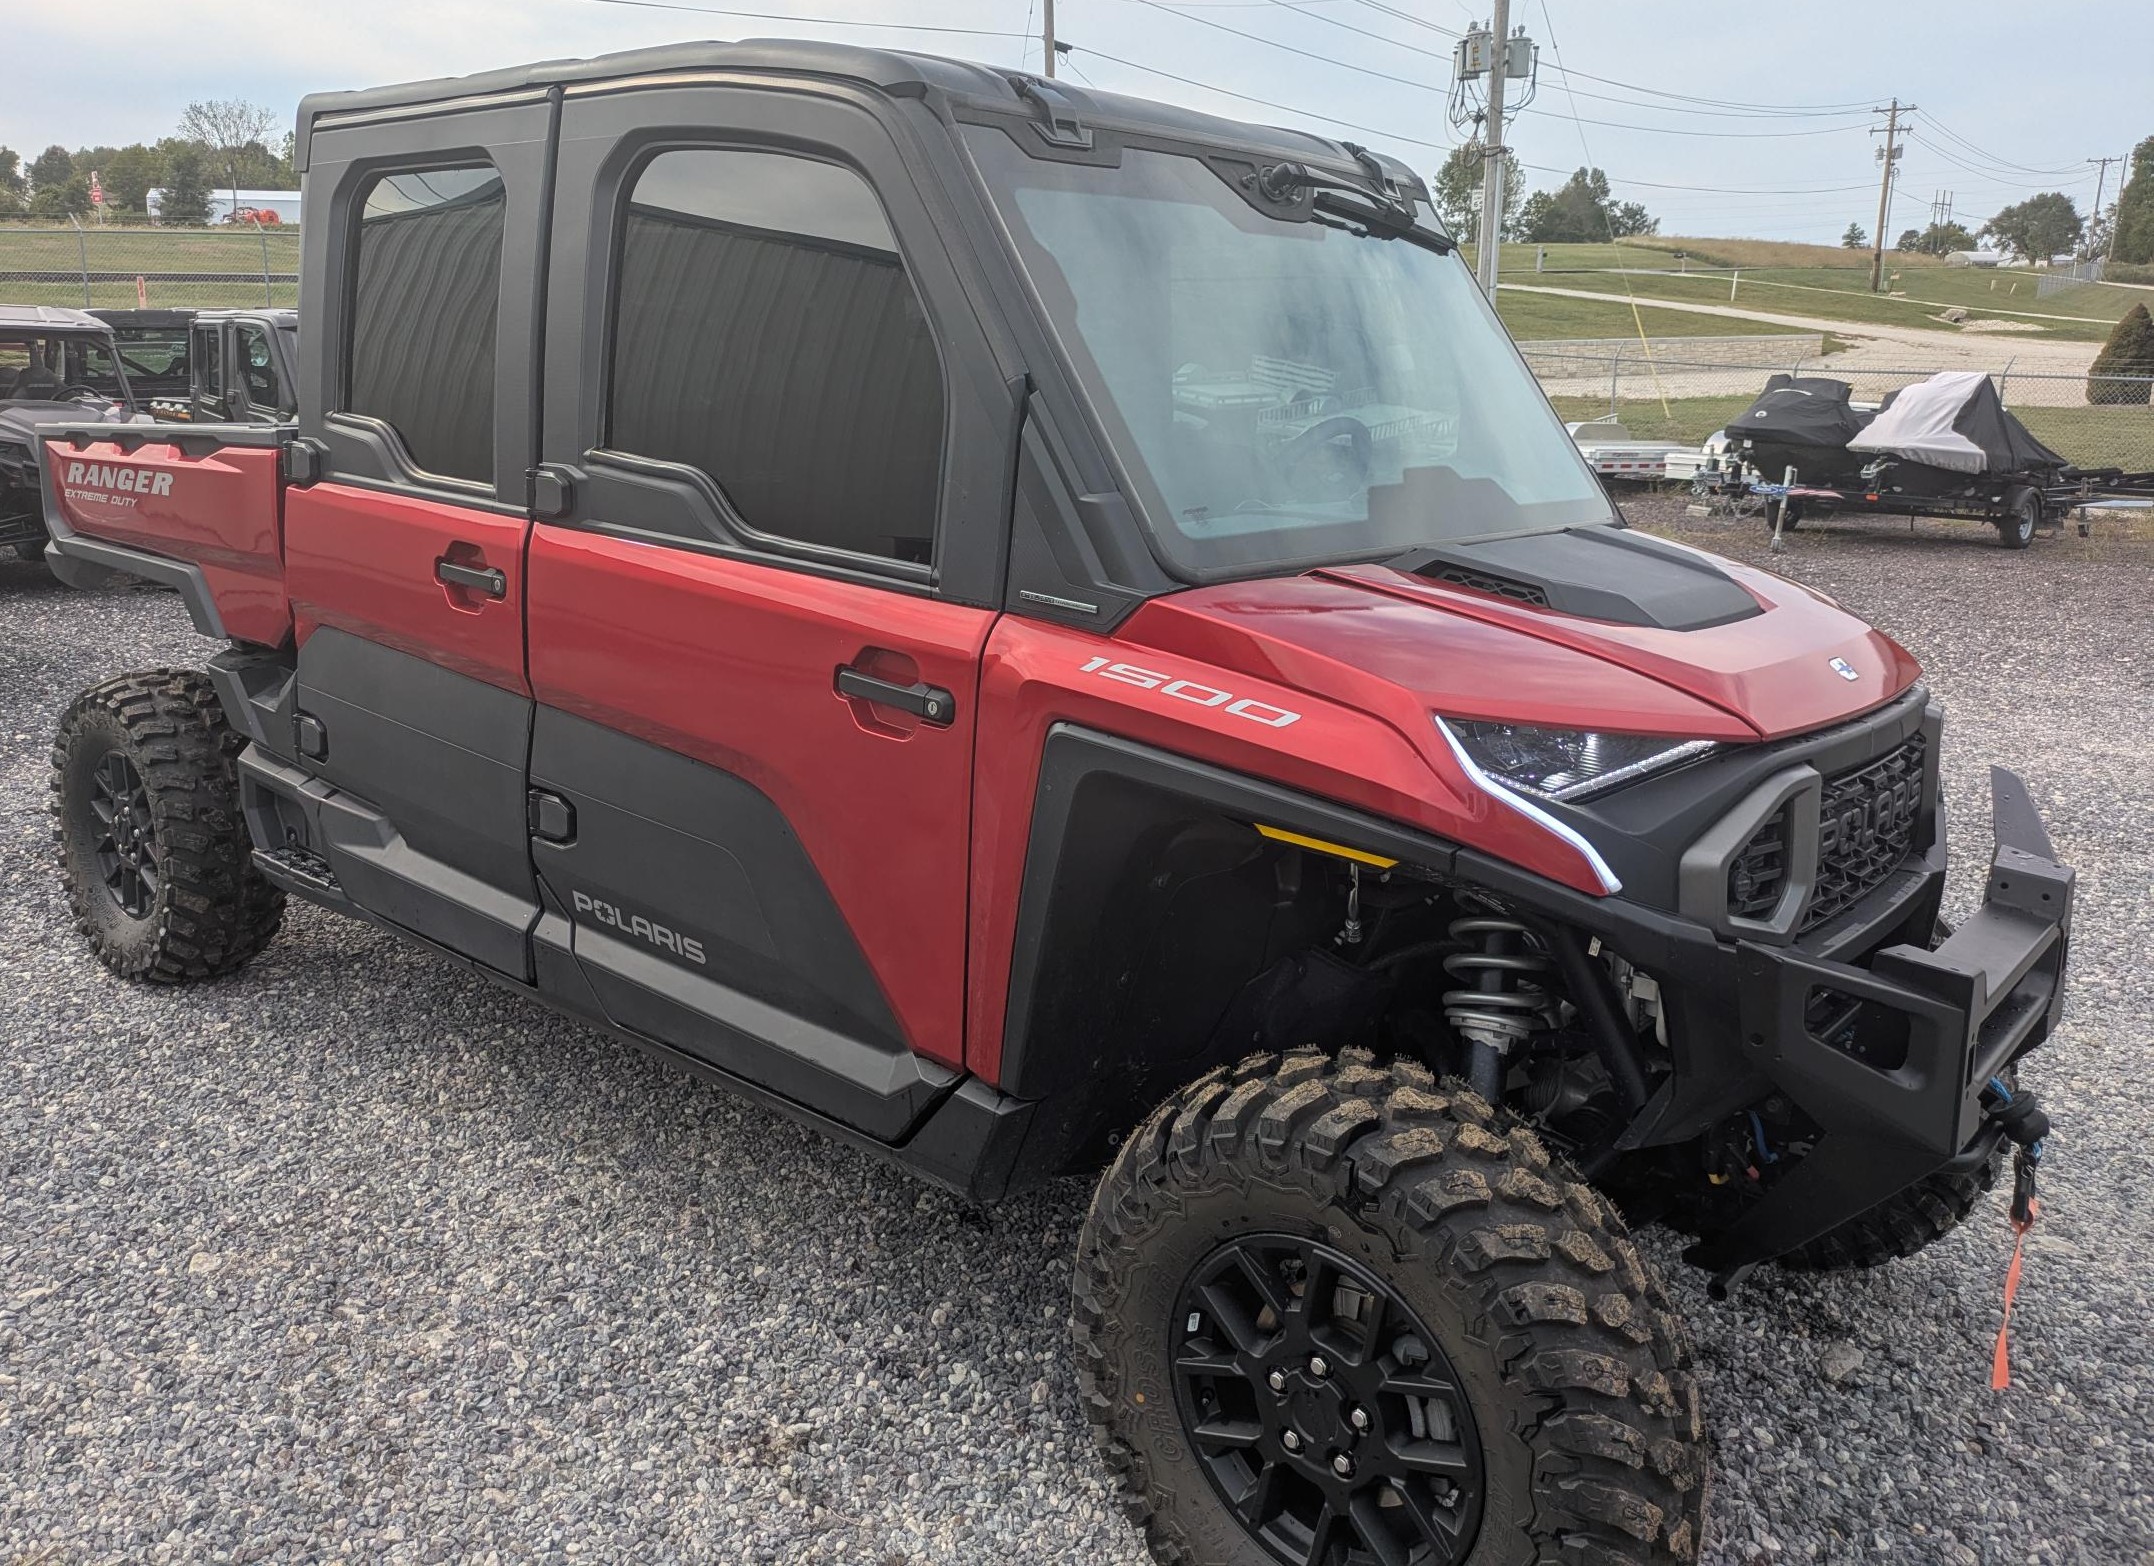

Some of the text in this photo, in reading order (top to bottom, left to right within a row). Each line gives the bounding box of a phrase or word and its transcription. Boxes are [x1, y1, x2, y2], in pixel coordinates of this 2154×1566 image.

[65, 489, 138, 507] EXTREME DUTY
[68, 463, 173, 495] RANGER
[1080, 656, 1301, 727] 1500
[1820, 768, 1922, 854] POLARIS
[572, 890, 706, 964] POLARIS
